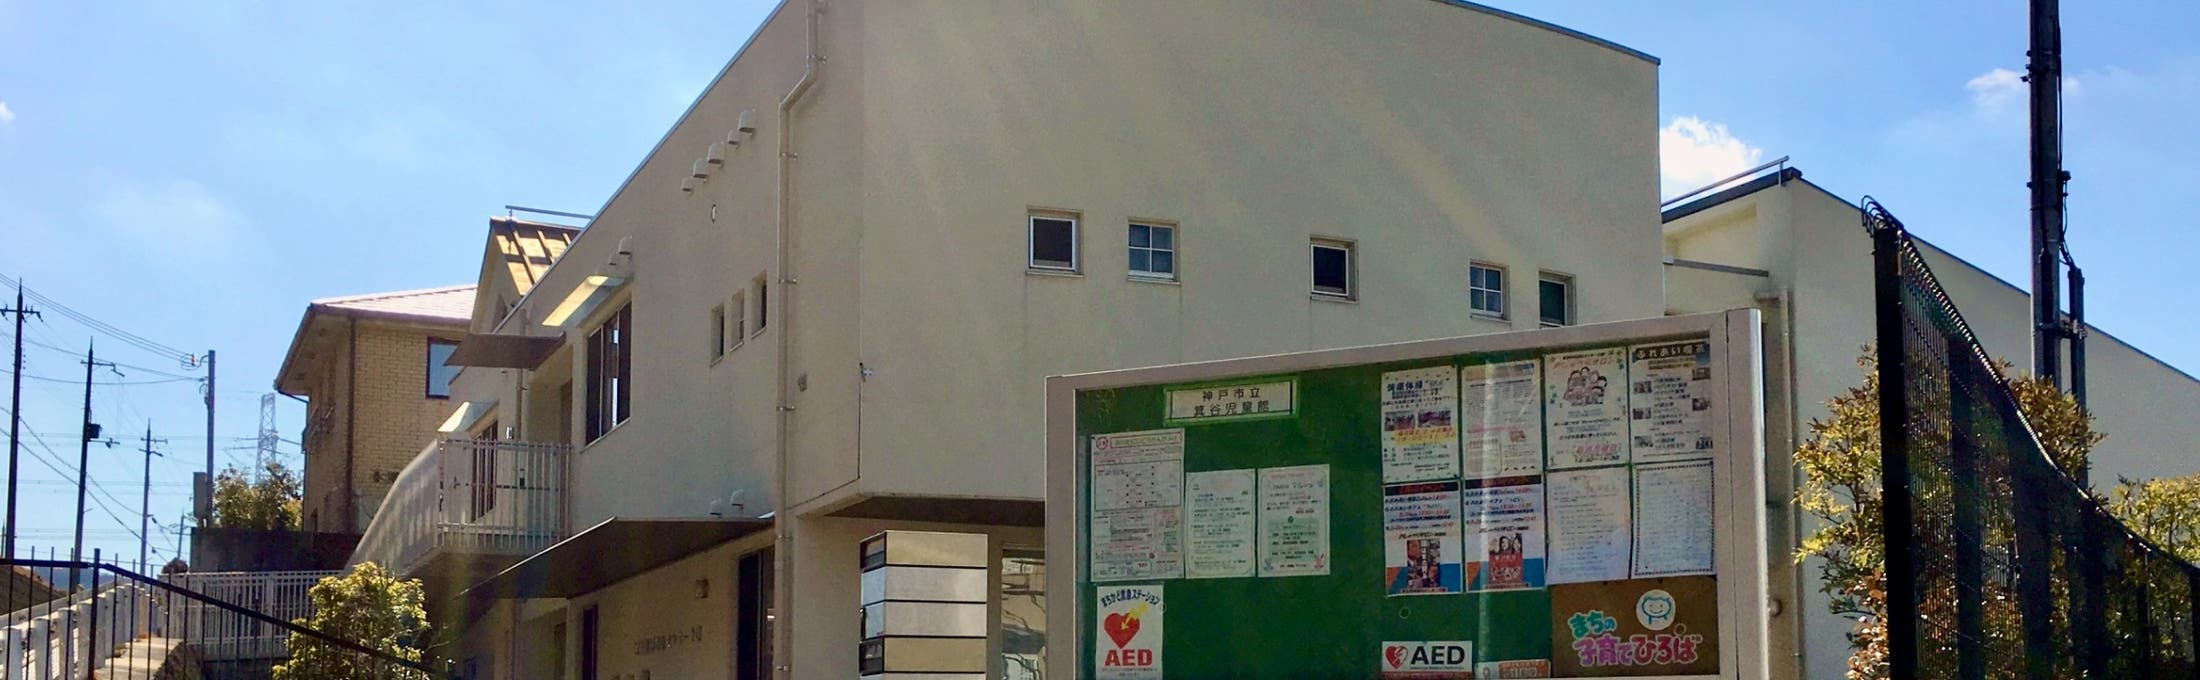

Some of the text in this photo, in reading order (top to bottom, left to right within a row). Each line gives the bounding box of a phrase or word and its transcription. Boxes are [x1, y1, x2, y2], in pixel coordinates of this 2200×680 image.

[1202, 387, 1261, 402] 神戸市立
[1568, 610, 1617, 639] まちの
[1105, 648, 1153, 667] AED
[1410, 645, 1466, 665] AED
[1572, 633, 1703, 667] 子育てひろば
